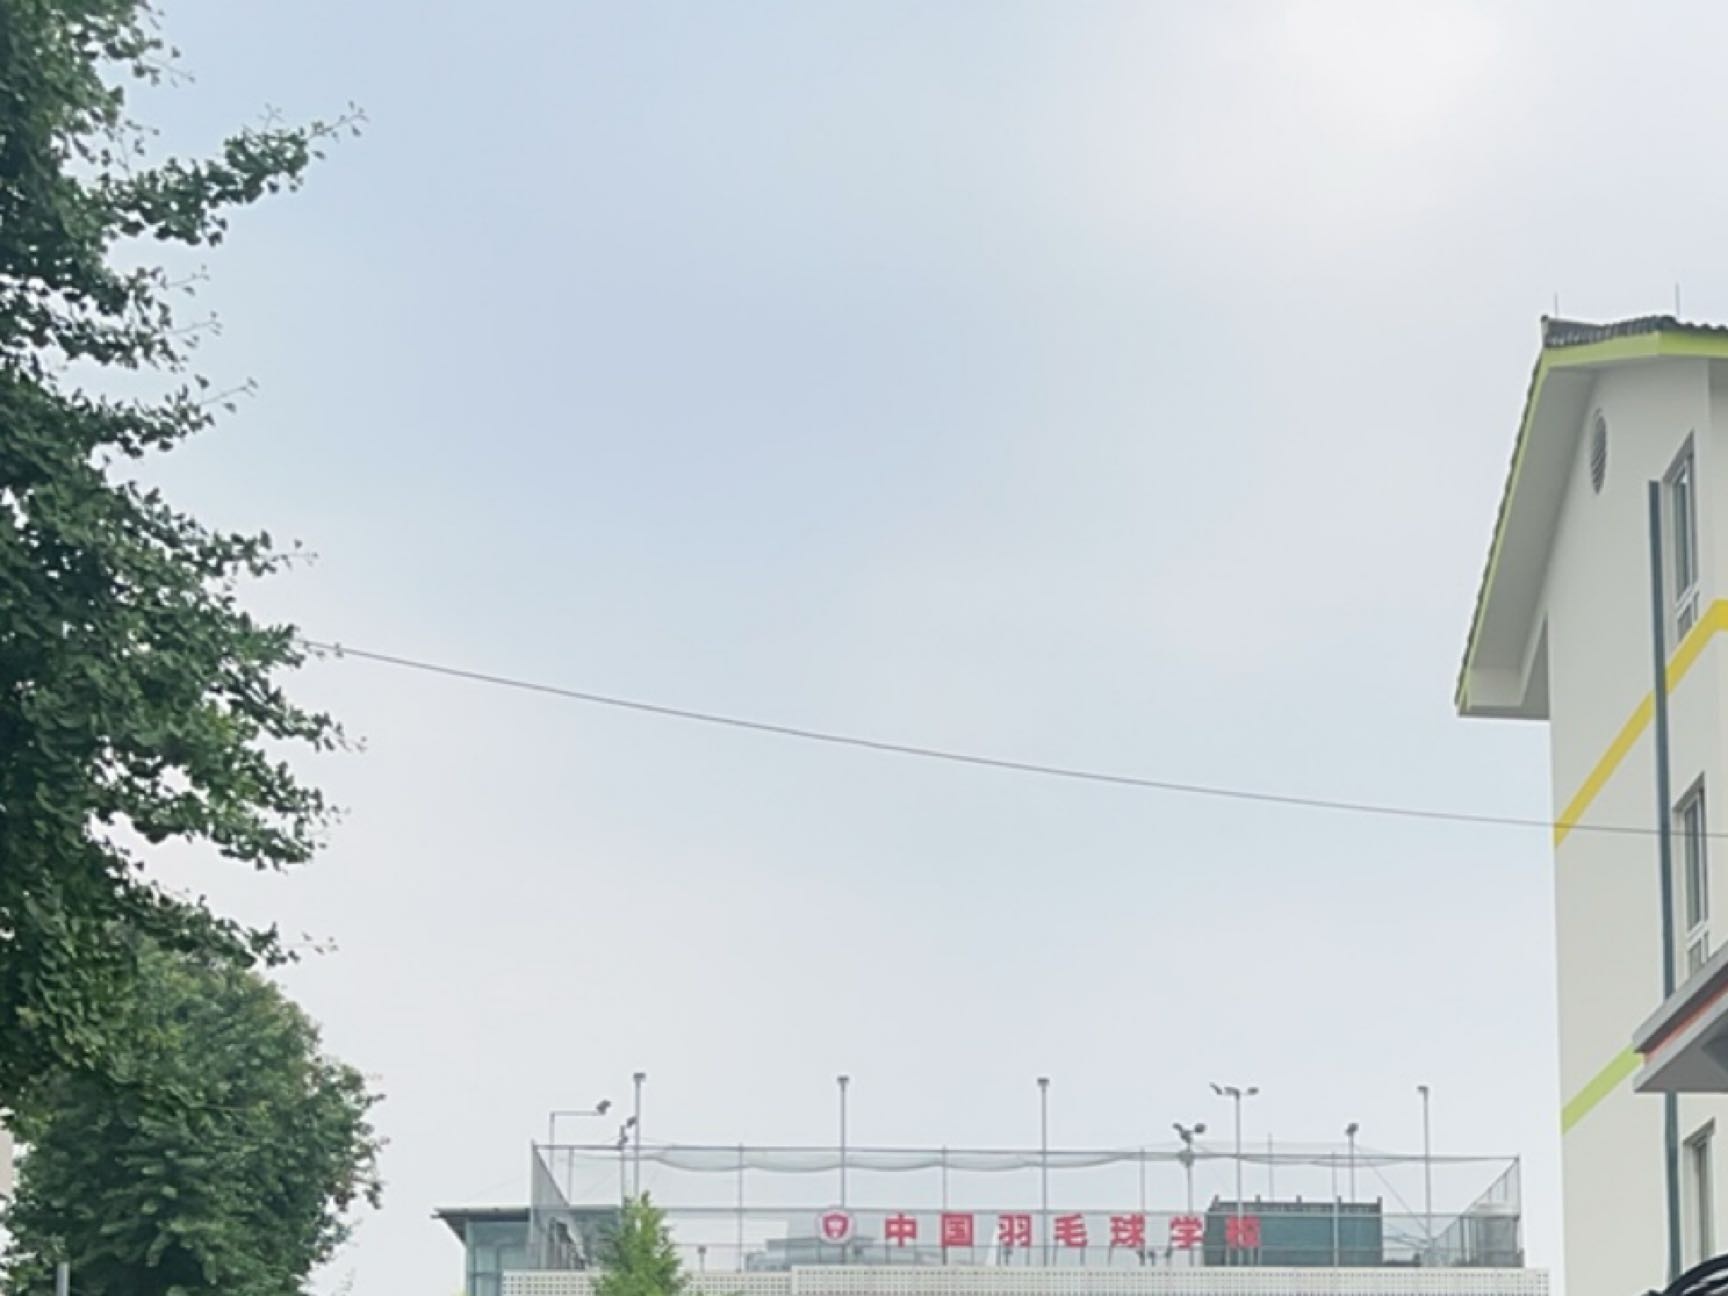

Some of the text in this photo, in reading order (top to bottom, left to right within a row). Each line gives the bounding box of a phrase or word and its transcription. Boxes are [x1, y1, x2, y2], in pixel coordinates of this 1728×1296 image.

[884, 1213, 1262, 1250] 中国羽毛球学校
